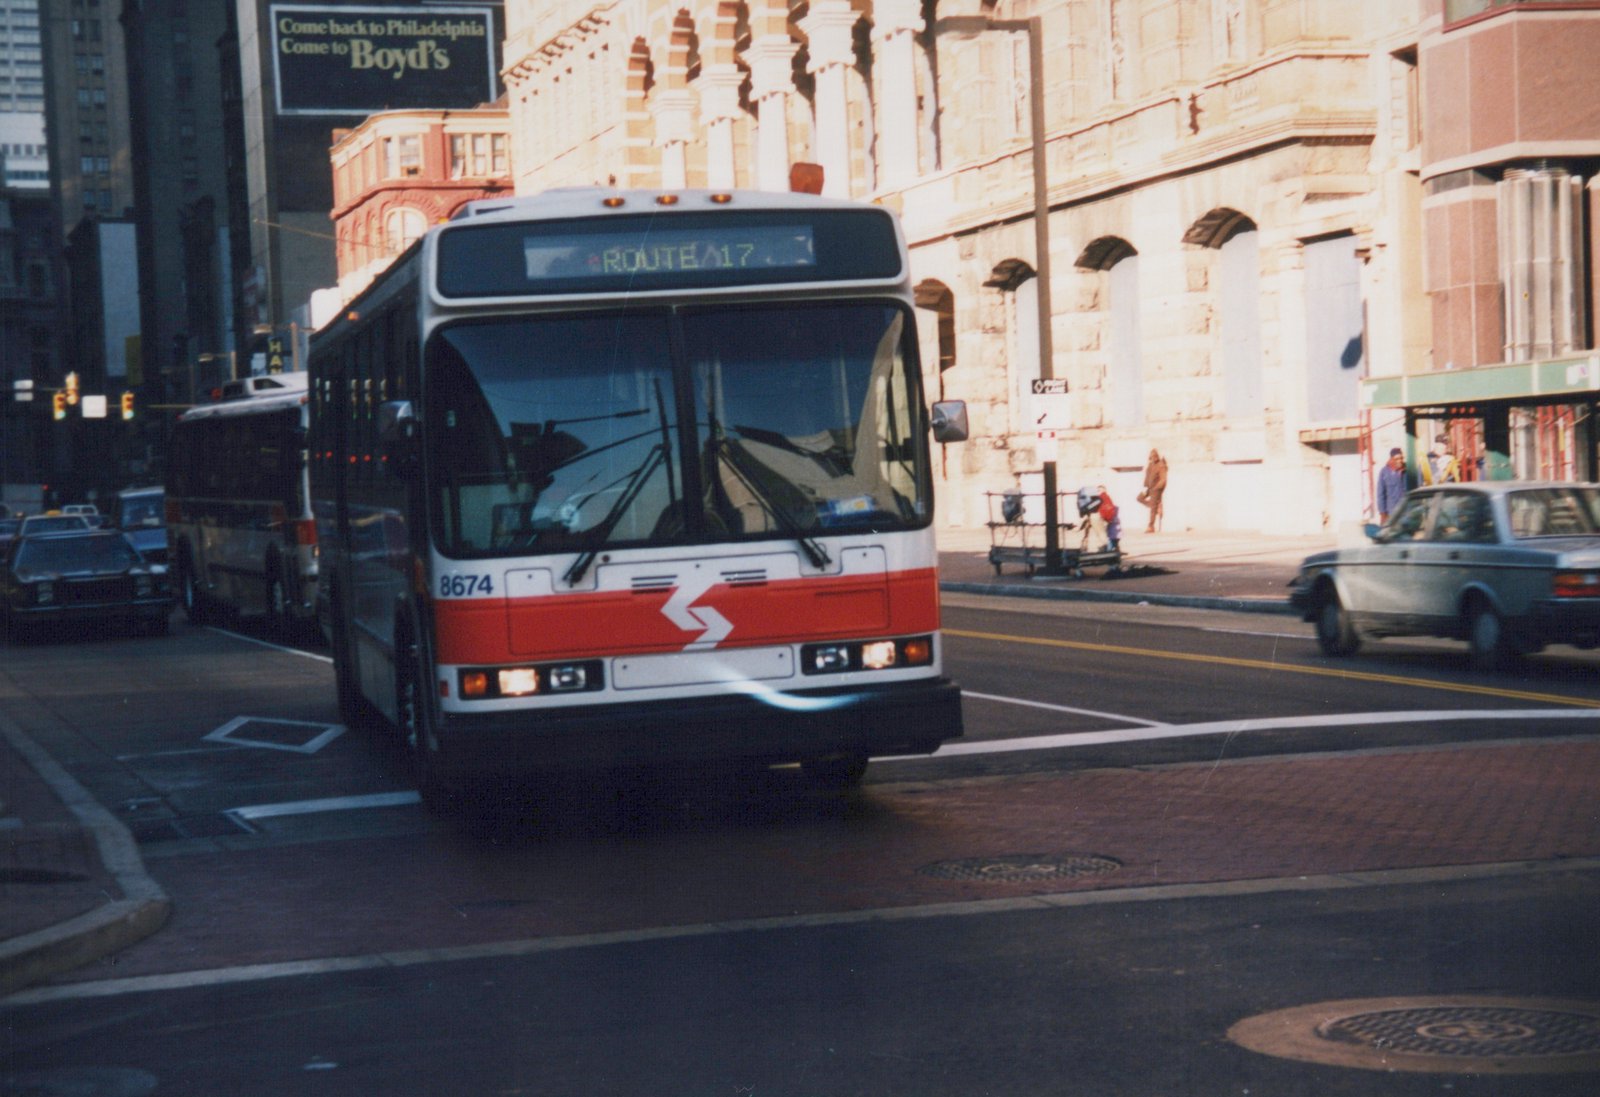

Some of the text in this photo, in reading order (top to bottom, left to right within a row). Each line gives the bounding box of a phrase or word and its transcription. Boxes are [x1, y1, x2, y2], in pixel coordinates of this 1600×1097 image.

[279, 17, 485, 41] Come back to Philadelphia
[280, 38, 450, 80] Come to Boyd's
[602, 242, 755, 273] ROUTE 17
[440, 574, 494, 596] 8674
